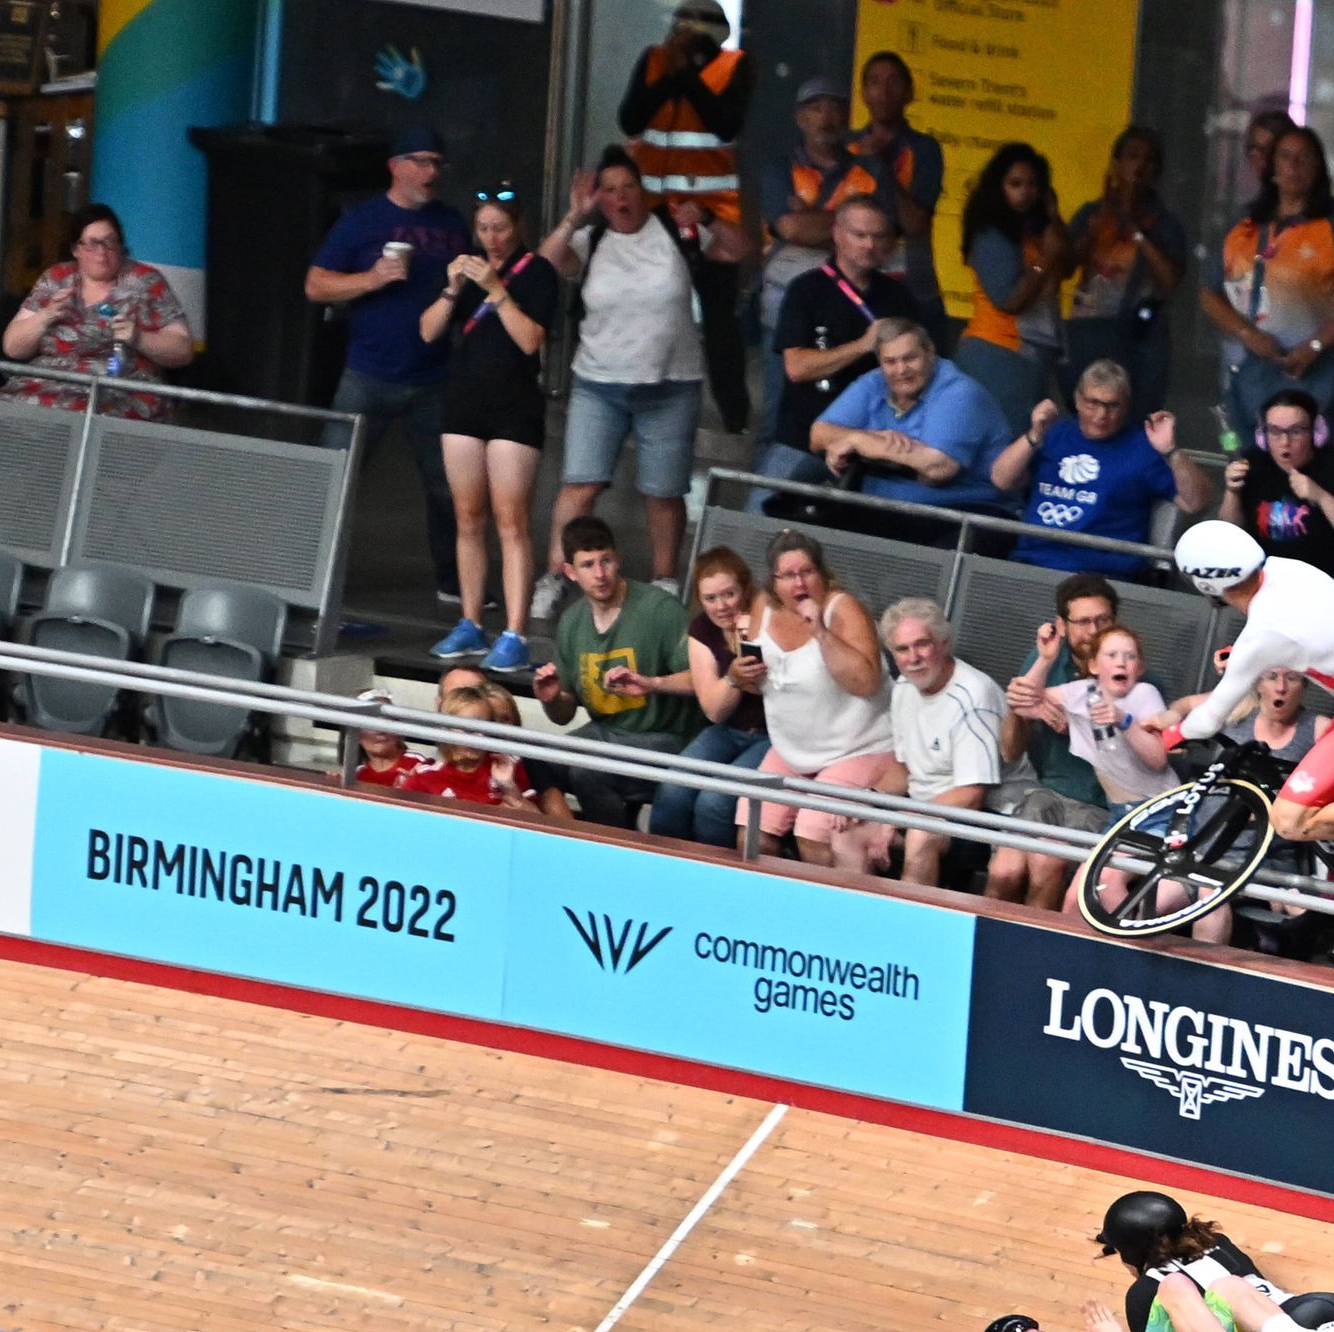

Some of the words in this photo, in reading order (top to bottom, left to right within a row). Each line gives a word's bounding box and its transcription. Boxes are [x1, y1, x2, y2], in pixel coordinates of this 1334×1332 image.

[1038, 481, 1074, 500] TEAM
[1075, 489, 1098, 505] GB
[1182, 565, 1242, 579] LAZER
[87, 827, 344, 923] BIRMINGHAM
[356, 874, 456, 943] 2022
[695, 931, 920, 1001] commonwealth
[753, 975, 856, 1022] games
